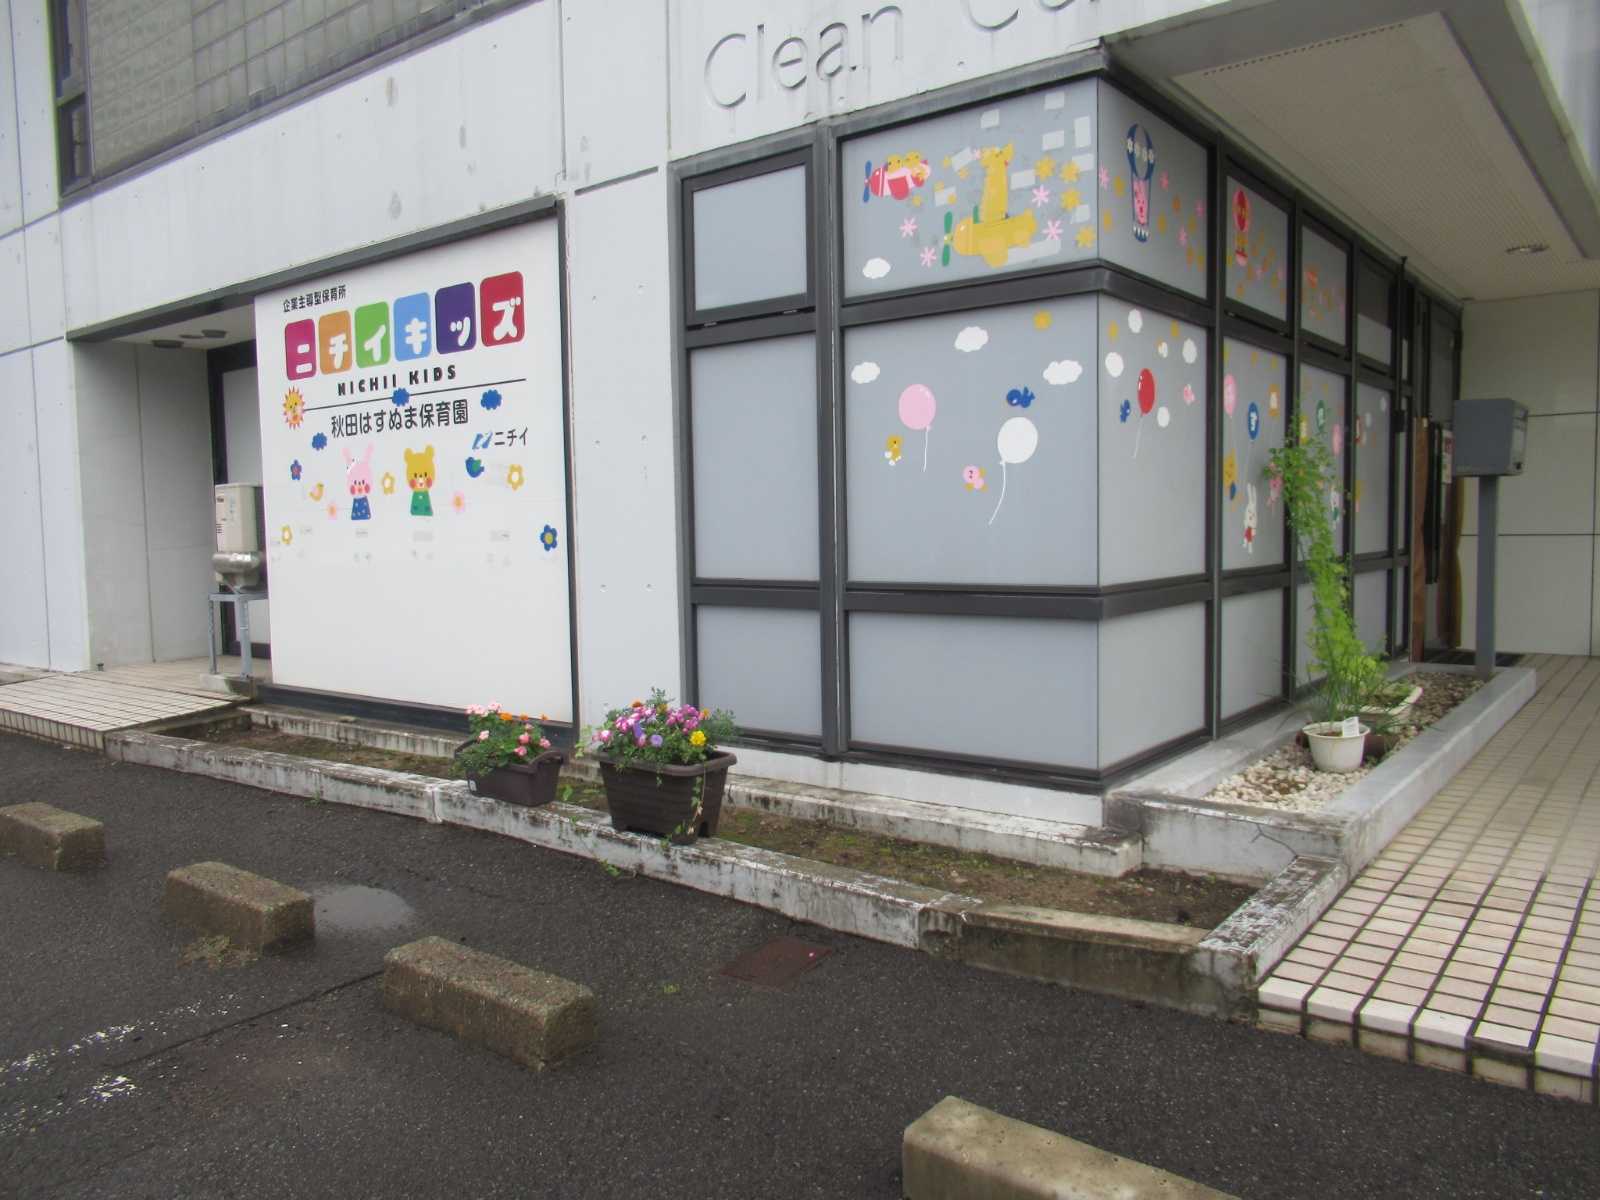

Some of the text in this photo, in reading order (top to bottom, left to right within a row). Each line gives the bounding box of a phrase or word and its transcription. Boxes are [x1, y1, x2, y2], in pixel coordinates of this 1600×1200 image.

[704, 5, 904, 108] Clean
[284, 285, 347, 313] 企業主導型保育所
[294, 293, 524, 375] ニチイキッズ
[337, 364, 457, 397] NICHII KIDS
[331, 398, 469, 438] 秋田はすぬま保育園
[494, 426, 529, 447] ニチイ
